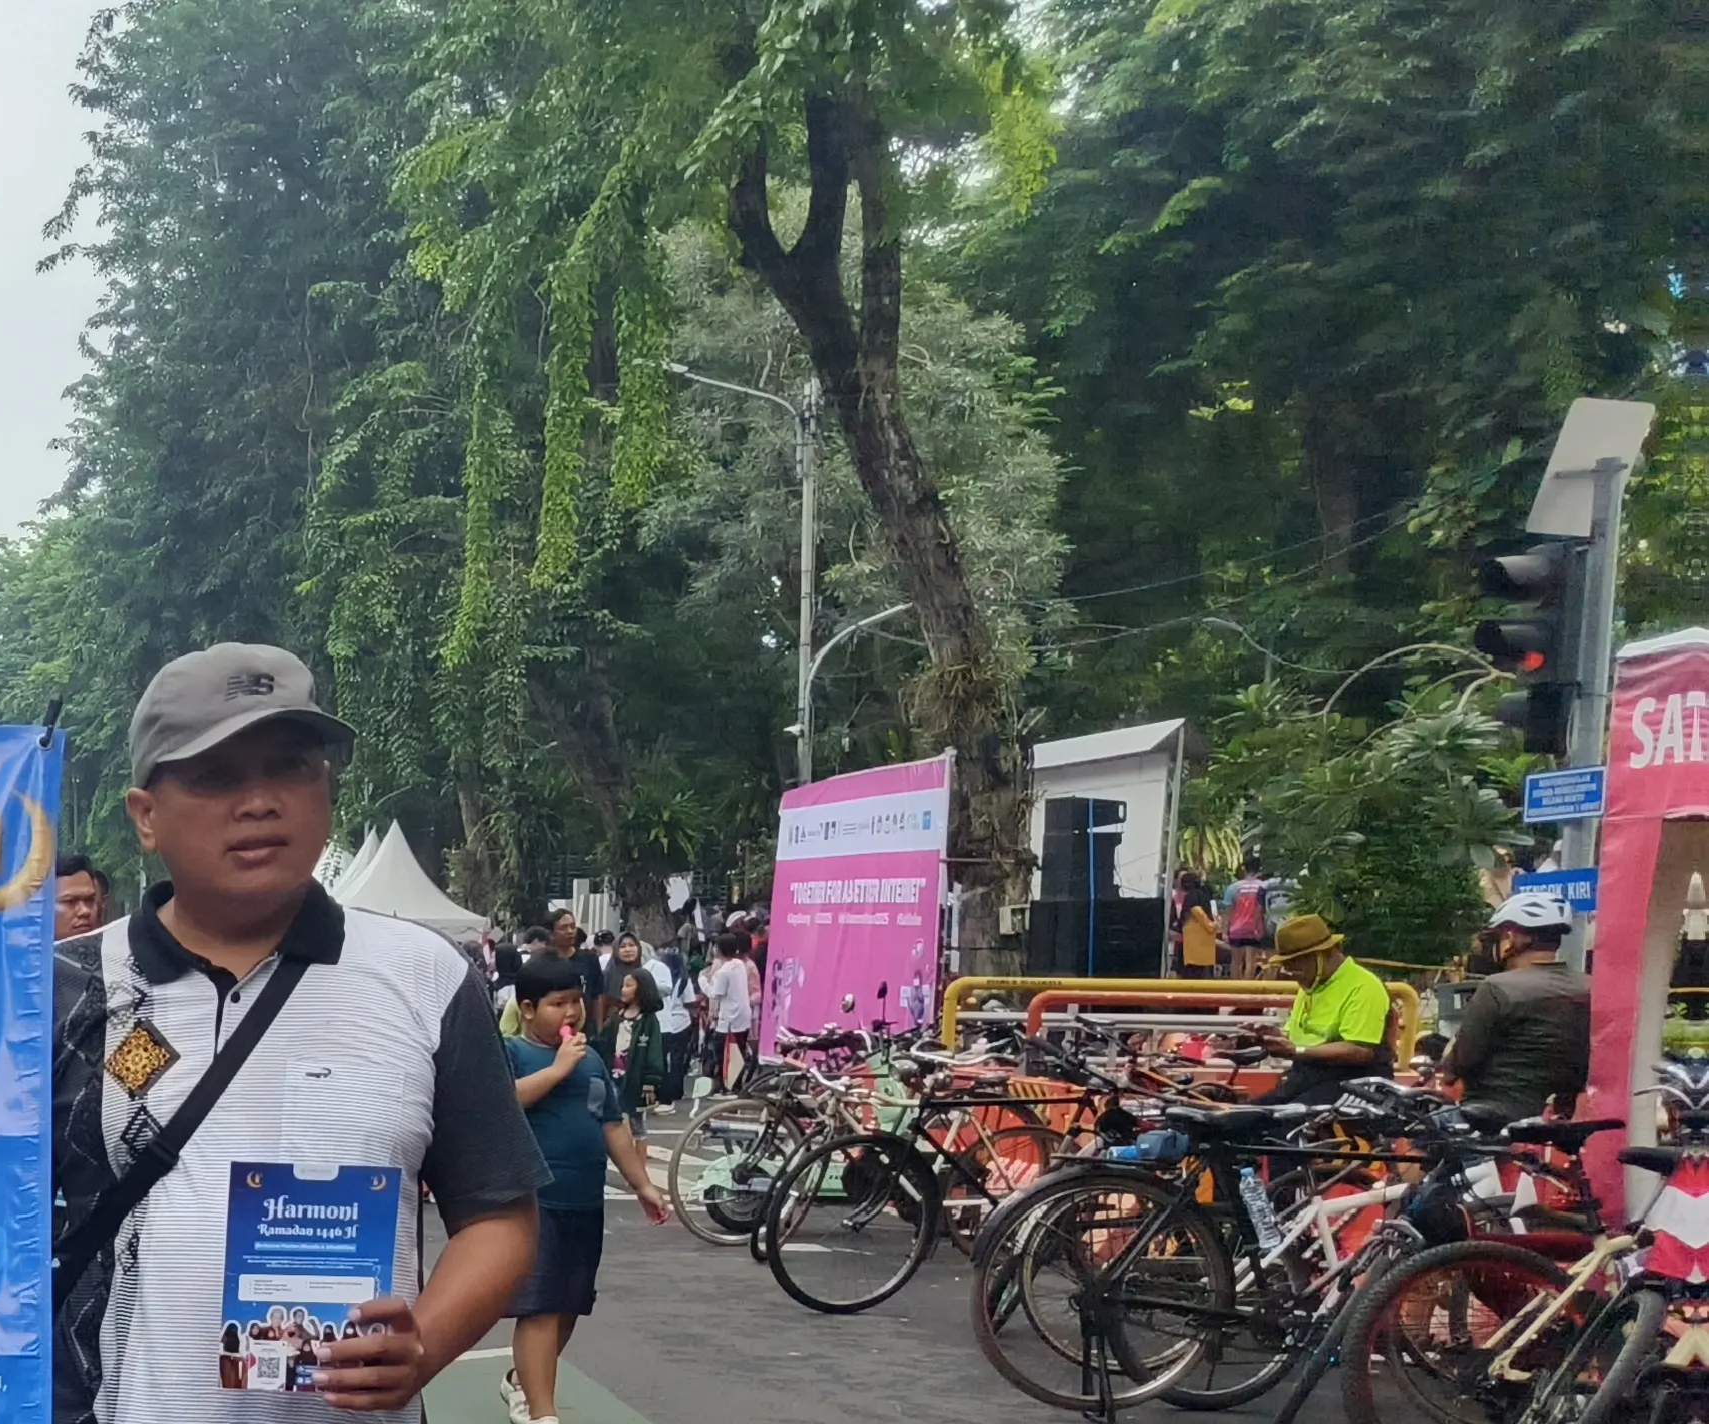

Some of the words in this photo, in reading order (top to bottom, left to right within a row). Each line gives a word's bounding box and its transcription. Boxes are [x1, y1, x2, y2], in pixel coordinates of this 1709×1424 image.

[1567, 881, 1591, 900] KIRI
[261, 1194, 358, 1222] Harmoni
[257, 1223, 313, 1237] Ramadan
[316, 1226, 342, 1239] 1446
[343, 1224, 360, 1239] H
